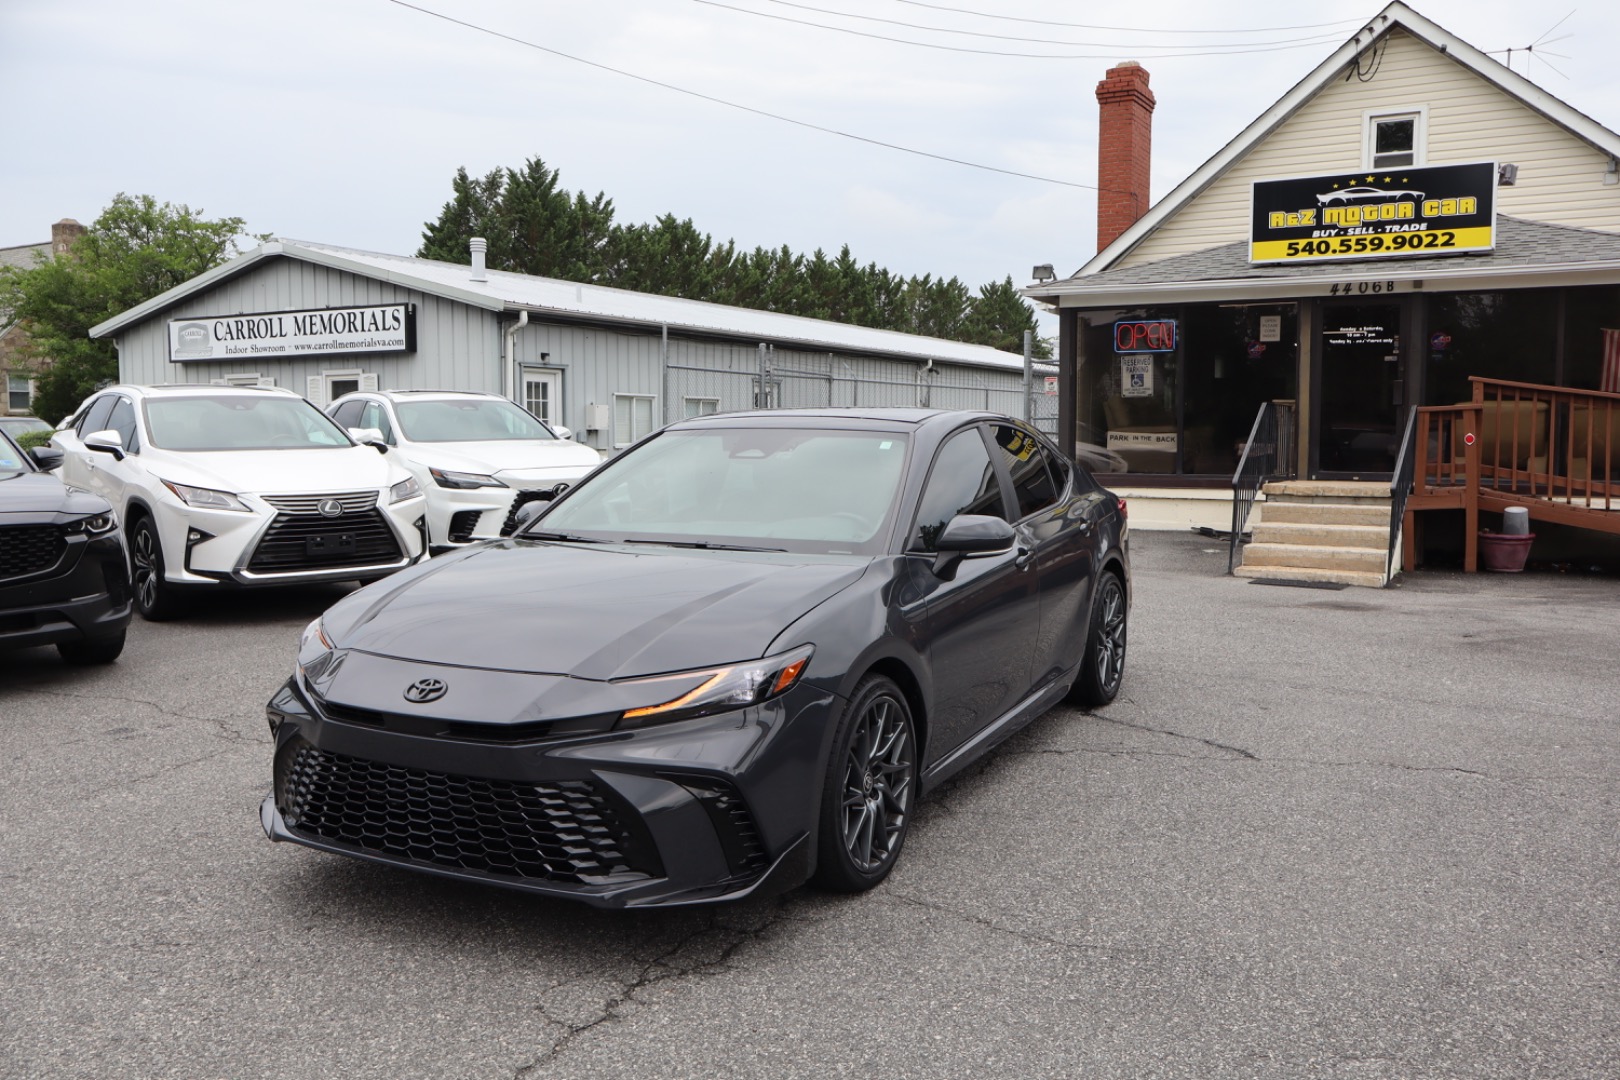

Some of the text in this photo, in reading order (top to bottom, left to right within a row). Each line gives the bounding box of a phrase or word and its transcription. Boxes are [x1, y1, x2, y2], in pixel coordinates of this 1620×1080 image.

[1323, 201, 1415, 228] MOTOR
[1312, 223, 1428, 238] BUY SELL TRADE
[1286, 231, 1456, 257] 540.559.9022
[214, 308, 401, 341] CARROLL MEMORIALS
[1117, 323, 1174, 349] OPEN
[225, 337, 404, 354] Indoor Showroom www.carrollmemorialsva.com
[1109, 434, 1129, 442] PARK
